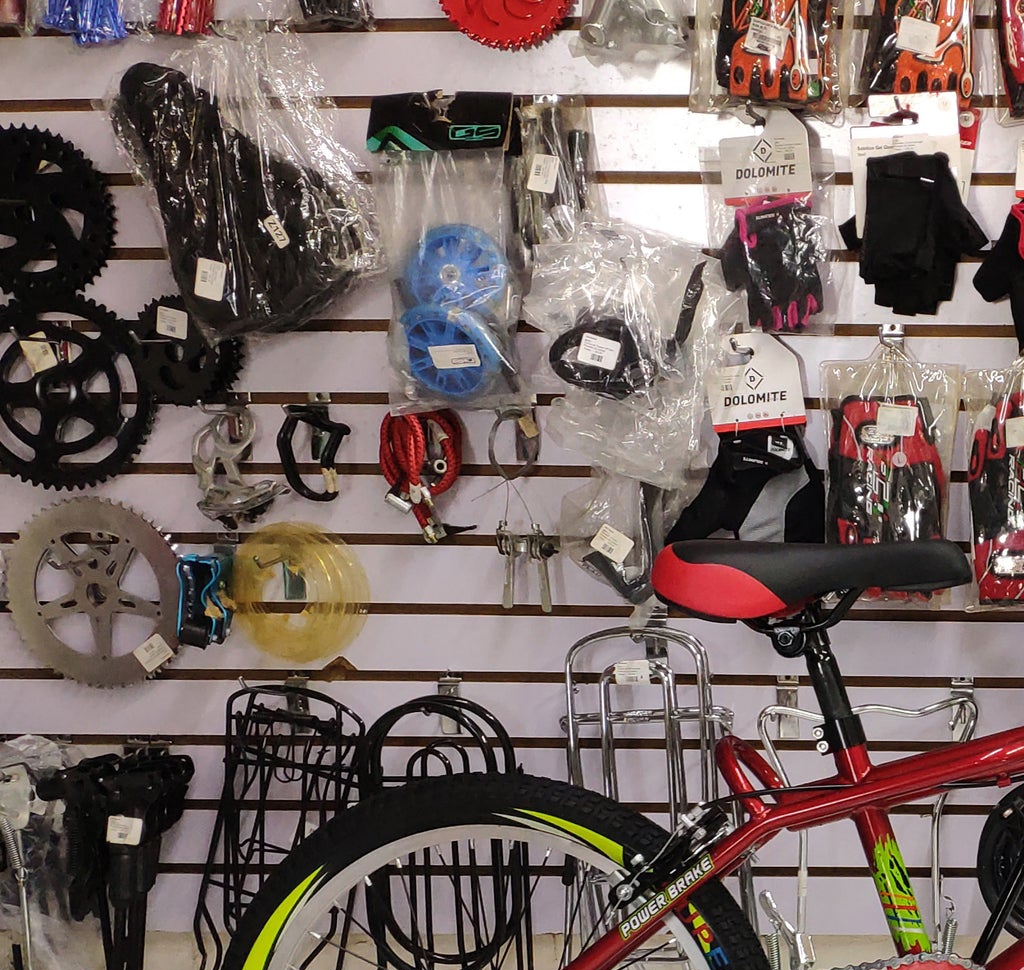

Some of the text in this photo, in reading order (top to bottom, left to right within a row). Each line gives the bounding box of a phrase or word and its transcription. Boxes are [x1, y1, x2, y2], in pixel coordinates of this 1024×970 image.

[735, 163, 797, 180] DOLOMITE
[723, 390, 788, 407] DOLOMITE
[620, 856, 713, 939] POWER BRAKE
